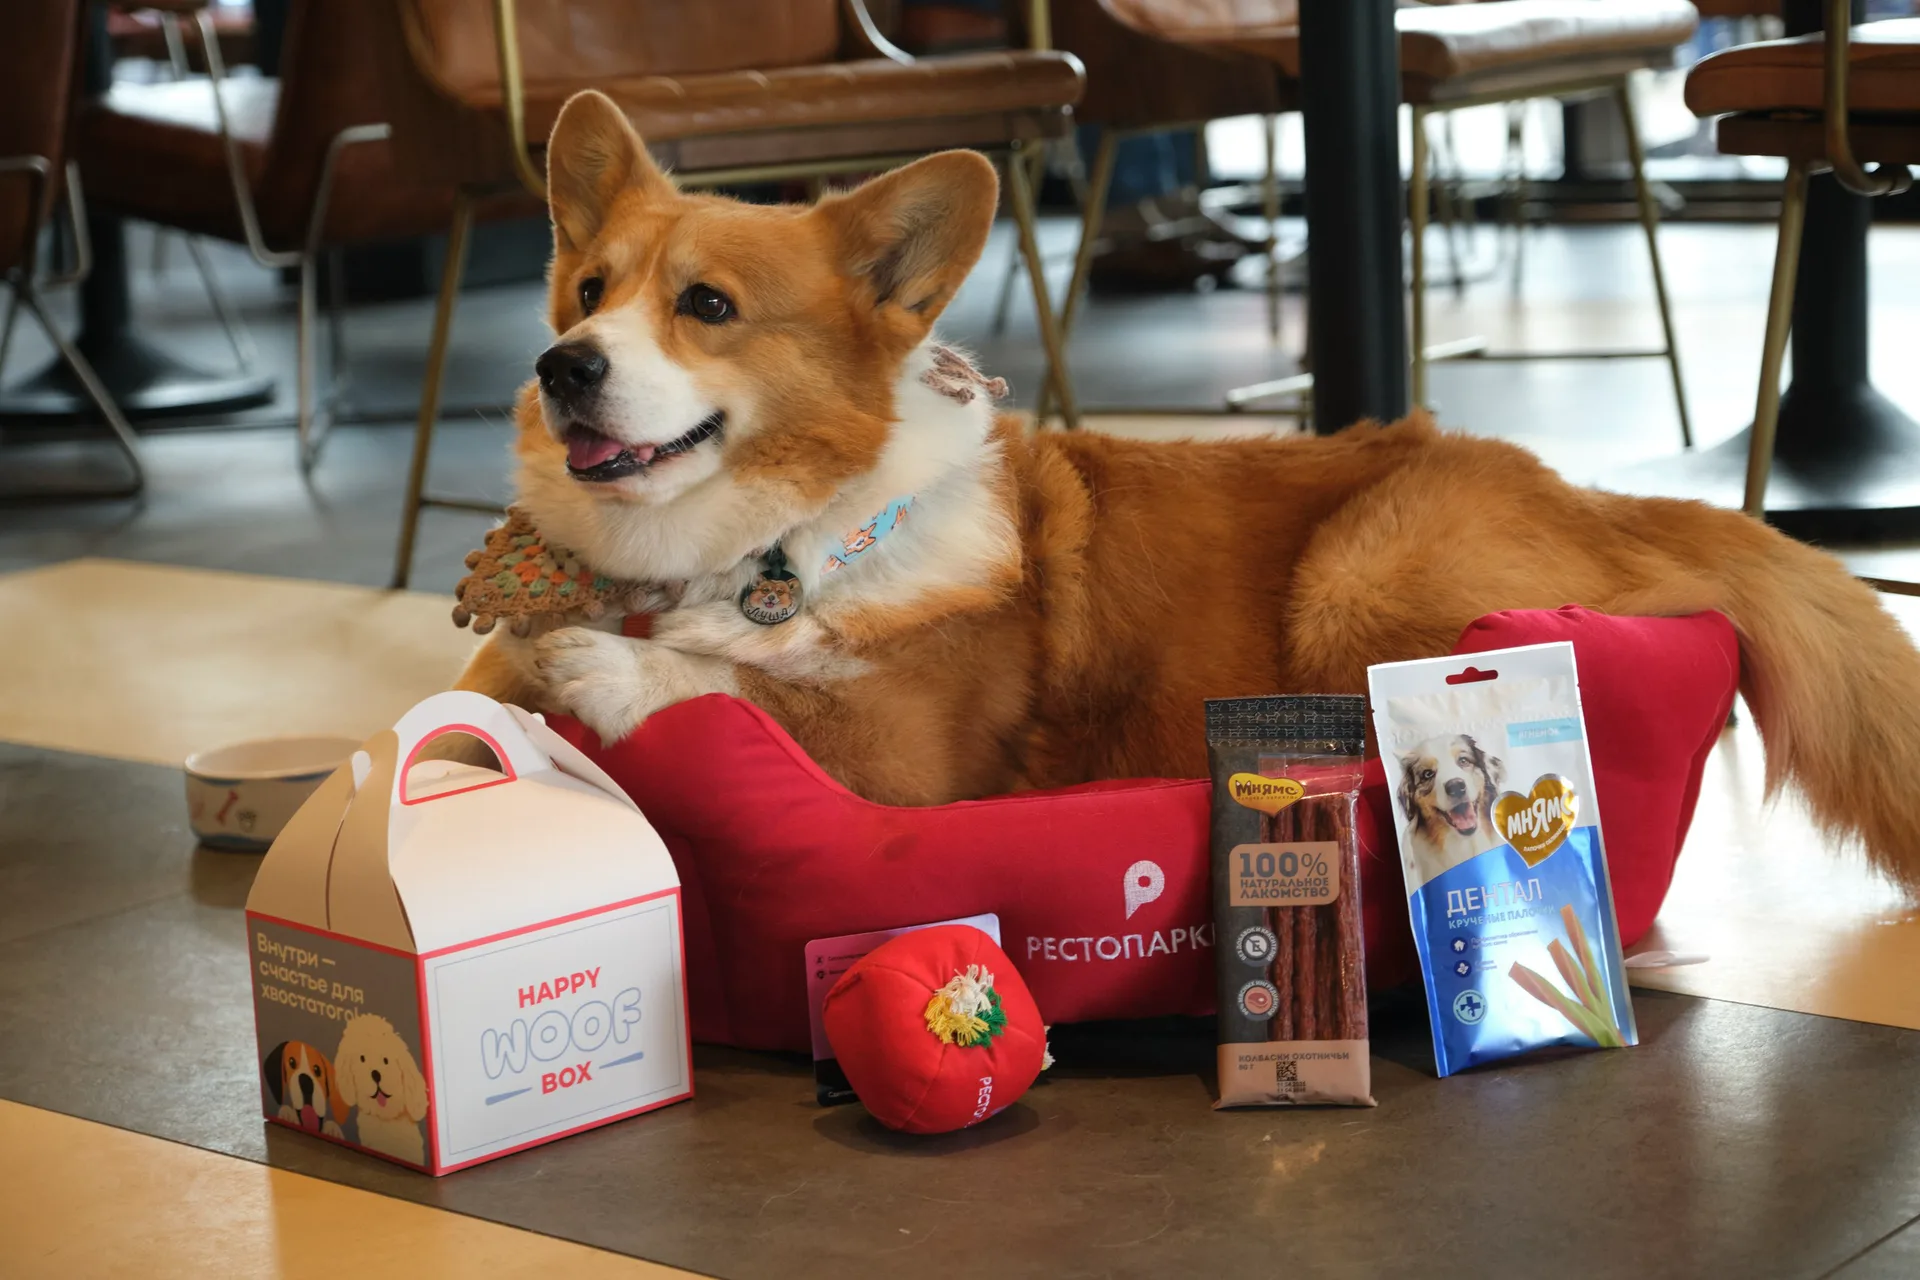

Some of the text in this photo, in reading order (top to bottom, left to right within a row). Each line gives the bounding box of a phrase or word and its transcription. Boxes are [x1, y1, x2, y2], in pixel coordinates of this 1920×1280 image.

[1240, 851, 1328, 878] 100%
[1240, 877, 1329, 888] НАТУРАЛЬНОЕ
[1240, 886, 1330, 899] ЛАКОМСТВО
[1446, 878, 1543, 918] ДЕНТАЛ
[257, 932, 319, 968] Внутри
[1026, 922, 1216, 962] РЕСТОПАРК
[260, 961, 364, 1004] счастье для
[518, 966, 601, 1009] HAPPY
[481, 987, 642, 1080] WOOF
[1238, 1052, 1350, 1063] КОЛБАСКИ ОХОТНИЧЬИ
[541, 1060, 593, 1095] BOX
